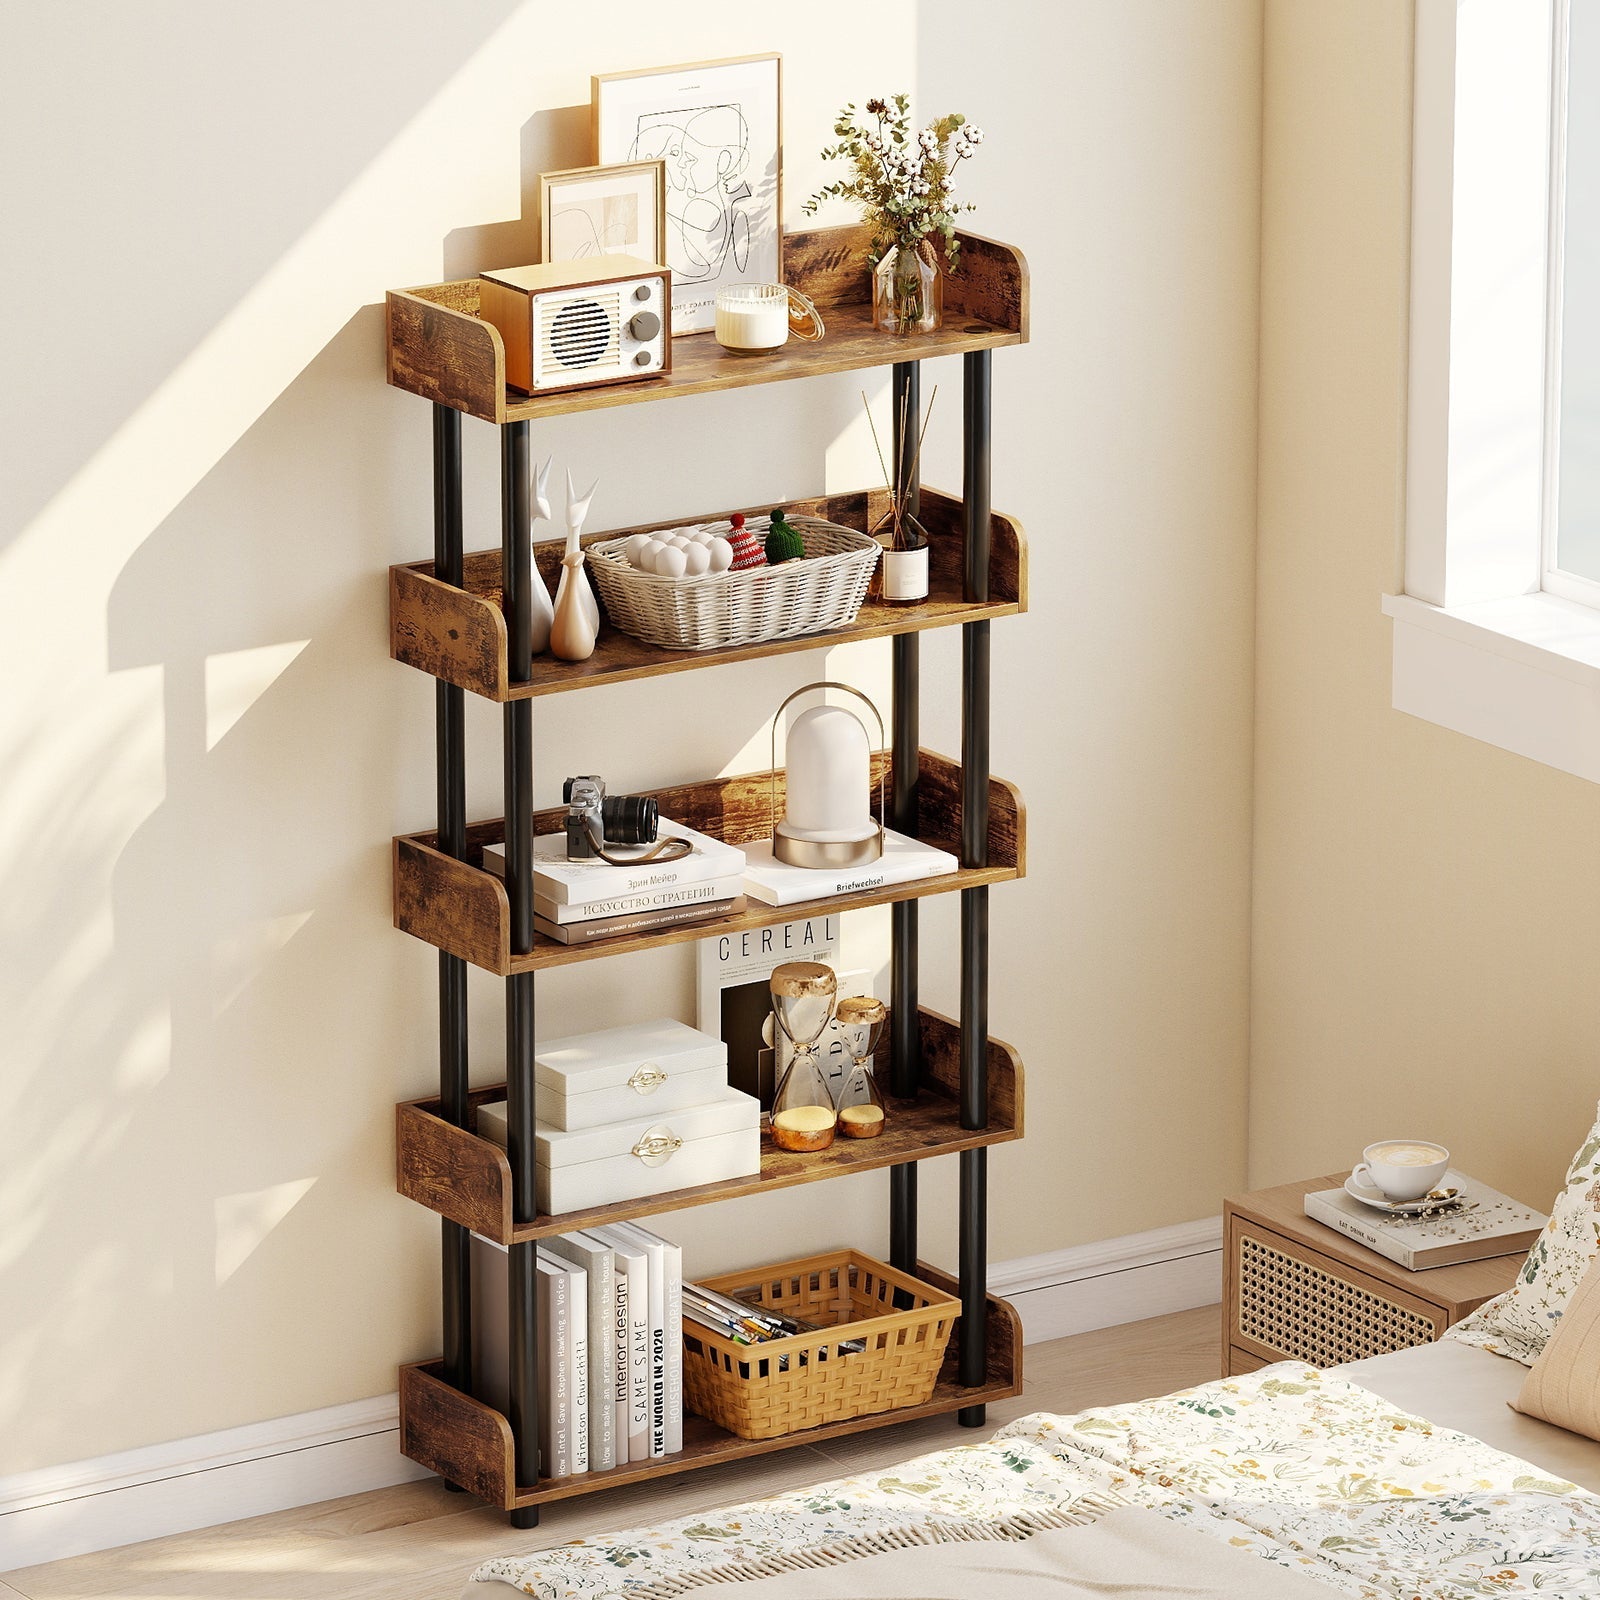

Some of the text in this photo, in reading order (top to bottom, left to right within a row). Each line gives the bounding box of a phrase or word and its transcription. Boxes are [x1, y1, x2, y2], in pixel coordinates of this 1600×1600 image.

[628, 873, 677, 890] Эрин Мейер
[836, 876, 884, 891] Briefwechsel
[583, 887, 715, 915] ИСКУССТВО СТРАТЕГИИ
[719, 918, 834, 961] CEREAL
[1339, 1220, 1347, 1229] EAT
[1350, 1226, 1364, 1238] DRINK
[601, 1255, 610, 1283] house
[557, 1278, 565, 1305] Voice
[601, 1288, 609, 1304] the
[557, 1319, 567, 1356] Hawking
[615, 1283, 628, 1402] Interior design
[602, 1325, 611, 1383] arrangement
[669, 1280, 680, 1424] HOUSEHOLD DECORATES
[557, 1361, 567, 1397] Stephen
[634, 1320, 647, 1422] SAME SAME
[576, 1339, 586, 1465] Winston Churchill
[603, 1389, 610, 1399] an
[654, 1329, 663, 1454] THE WORLD IN 2020
[602, 1405, 610, 1426] make
[557, 1428, 565, 1453] Intel
[603, 1431, 610, 1441] to
